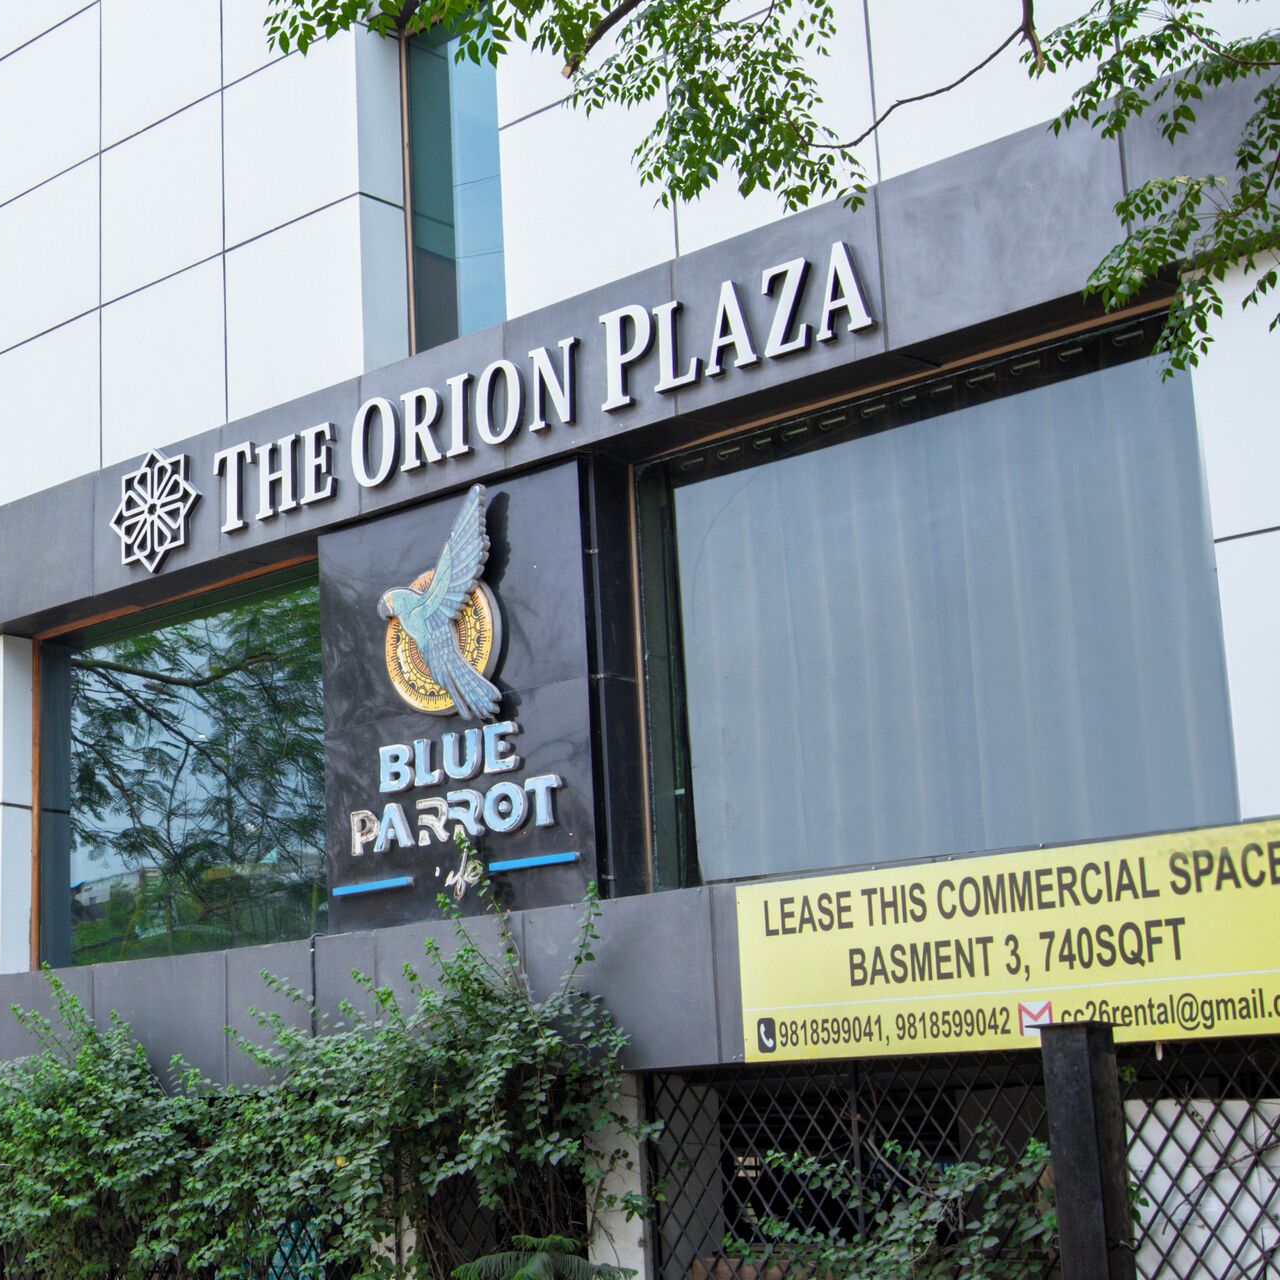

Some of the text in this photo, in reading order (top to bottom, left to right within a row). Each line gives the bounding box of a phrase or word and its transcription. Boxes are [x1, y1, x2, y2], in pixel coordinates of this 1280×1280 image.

[213, 240, 876, 535] THE ORION PLAZA
[379, 721, 520, 794] BLUE
[350, 774, 564, 857] PARROT
[763, 840, 1280, 937] LEASE THIS COMMERCIAL SPACE
[848, 917, 1186, 987] BASMENT 3, 740SQFT
[779, 1014, 890, 1047] 9818599041,
[895, 1006, 1012, 1041] 9818599042
